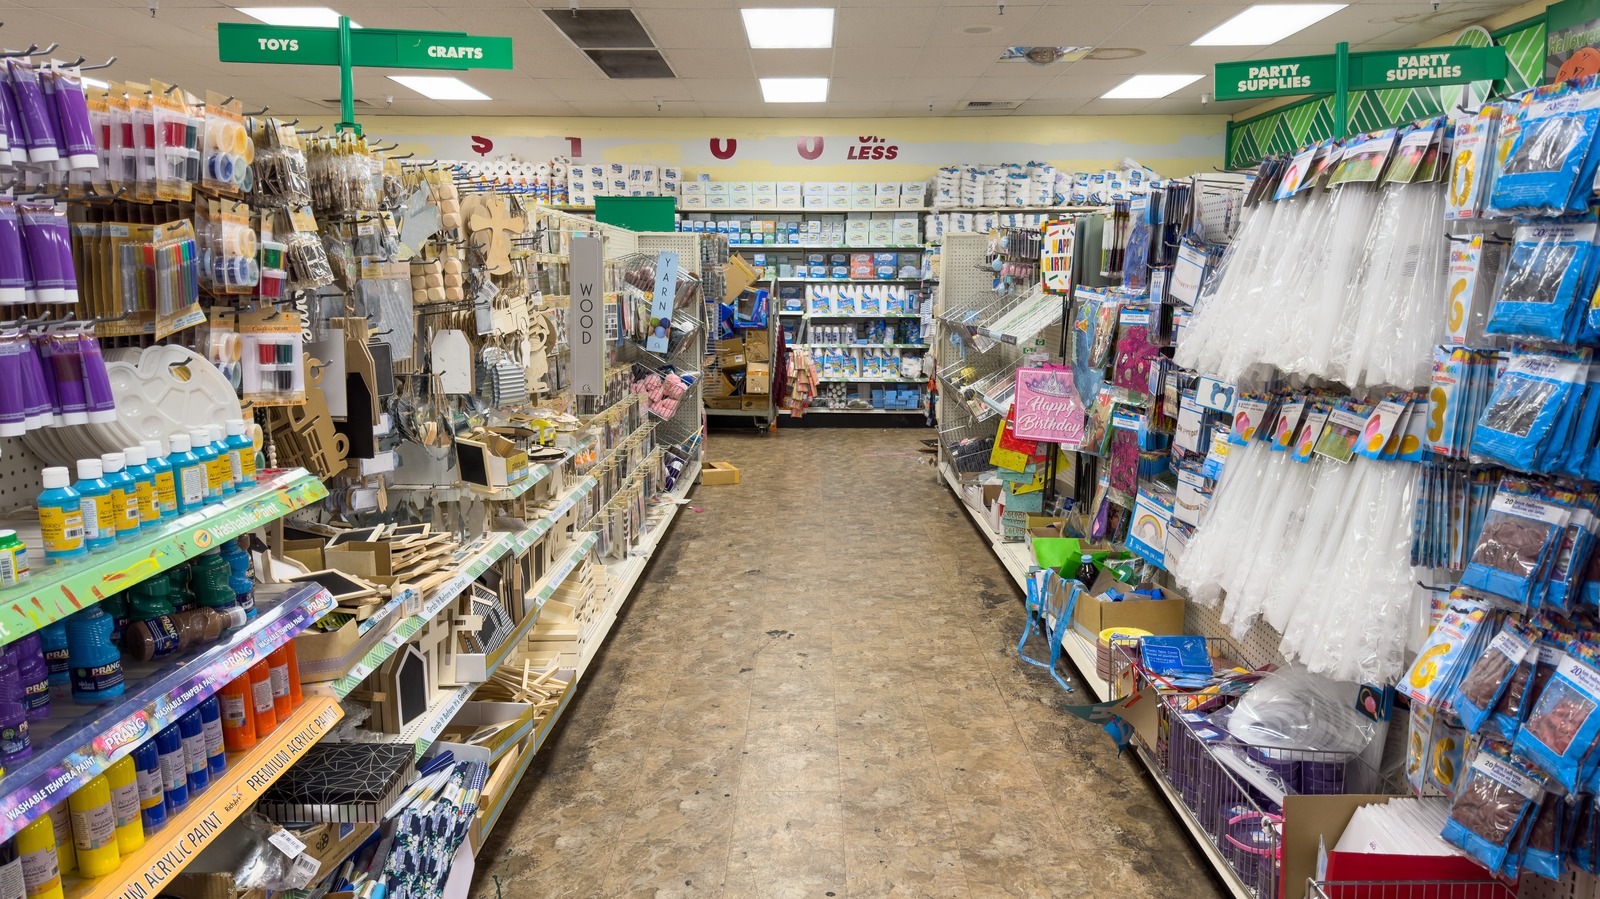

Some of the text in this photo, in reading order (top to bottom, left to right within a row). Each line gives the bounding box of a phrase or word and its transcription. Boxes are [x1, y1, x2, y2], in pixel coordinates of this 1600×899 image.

[257, 38, 299, 52] TOYS
[427, 45, 484, 60] CRAFTS
[1248, 64, 1300, 79] PARTY
[1398, 53, 1451, 69] PARTY
[1237, 75, 1311, 93] SUPPLIES
[1386, 65, 1462, 82] SUPPLIES
[846, 145, 899, 161] LESS
[658, 257, 671, 312] YARN
[579, 282, 594, 345] WOOD
[1025, 395, 1076, 418] Happy
[1018, 413, 1084, 438] Birthday
[208, 510, 259, 540] Washable
[306, 593, 332, 614] PRANG
[160, 615, 179, 639] PRANG
[91, 661, 121, 676] PRANG
[222, 646, 253, 670] PRANG
[154, 674, 219, 720] WASHABLE TEMPERA PAINT
[104, 717, 147, 751] PRANG
[430, 720, 443, 735] Grab
[245, 705, 339, 792] PREMIUM ACRYLIC PAINT
[6, 756, 97, 822] WASHABLE TEMPERA PAINT
[143, 839, 193, 890] ACRYLIC
[187, 811, 224, 848] PAINT
